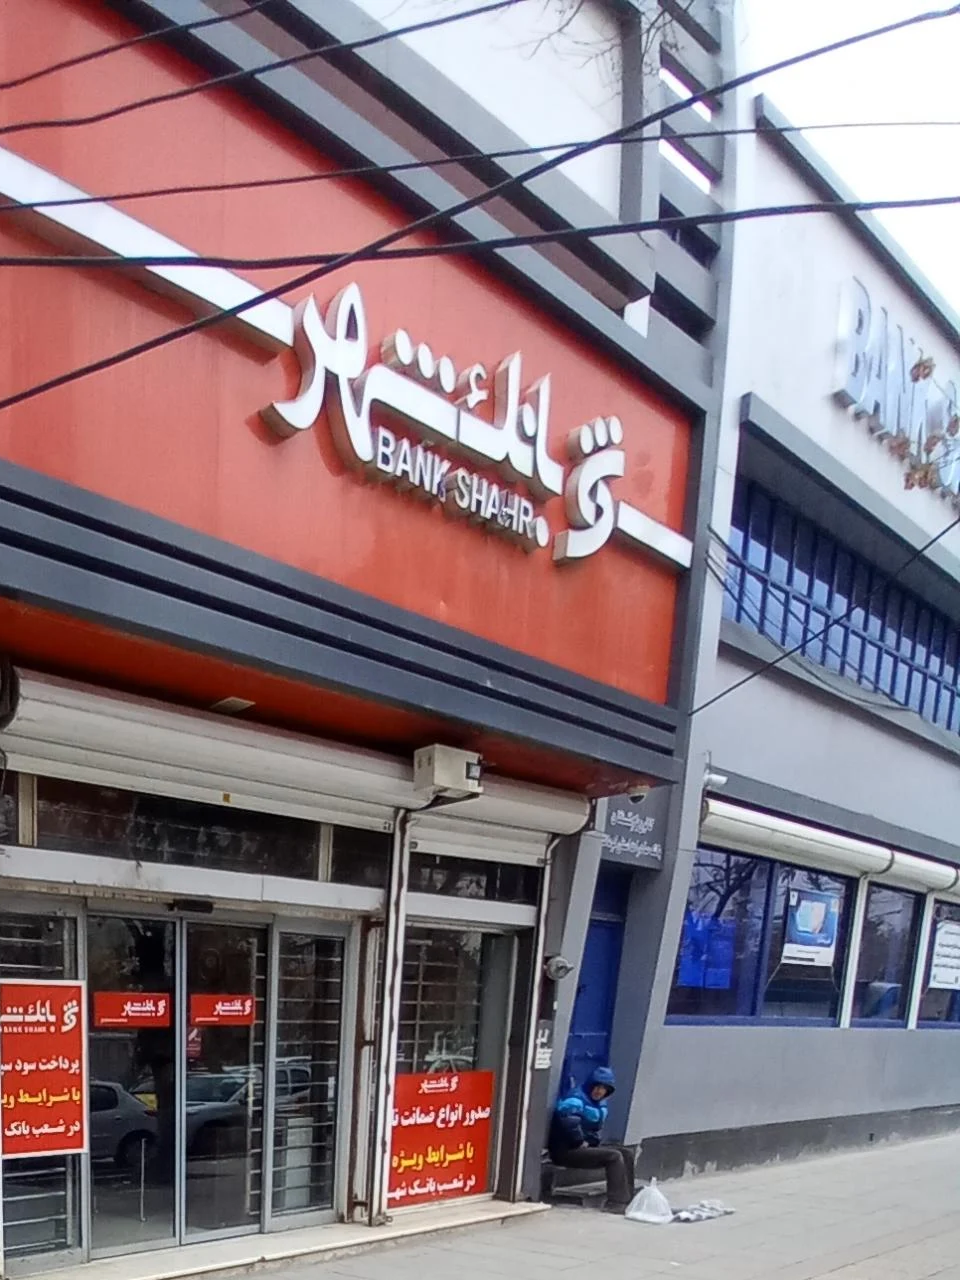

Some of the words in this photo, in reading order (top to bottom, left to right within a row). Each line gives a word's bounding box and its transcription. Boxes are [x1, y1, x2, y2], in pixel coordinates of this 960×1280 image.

[270, 281, 458, 462] شهر
[377, 428, 451, 503] BANK
[454, 467, 534, 540] SHAHR
[14, 1058, 37, 1075] سود
[38, 1055, 80, 1075] پرداخت
[17, 1087, 71, 1107] شرایط
[71, 1086, 81, 1105] با
[400, 1104, 437, 1127] ضمانت
[435, 1102, 463, 1129] انواع
[462, 1105, 492, 1127] صدور
[4, 1120, 30, 1139] بانک
[32, 1118, 66, 1138] شعب
[66, 1120, 81, 1137] در
[391, 1150, 425, 1174] ویژه
[425, 1142, 465, 1168] شرایط
[466, 1141, 475, 1163] با
[408, 1177, 437, 1196] بانک
[437, 1173, 465, 1195] شعب
[464, 1174, 476, 1193] در
